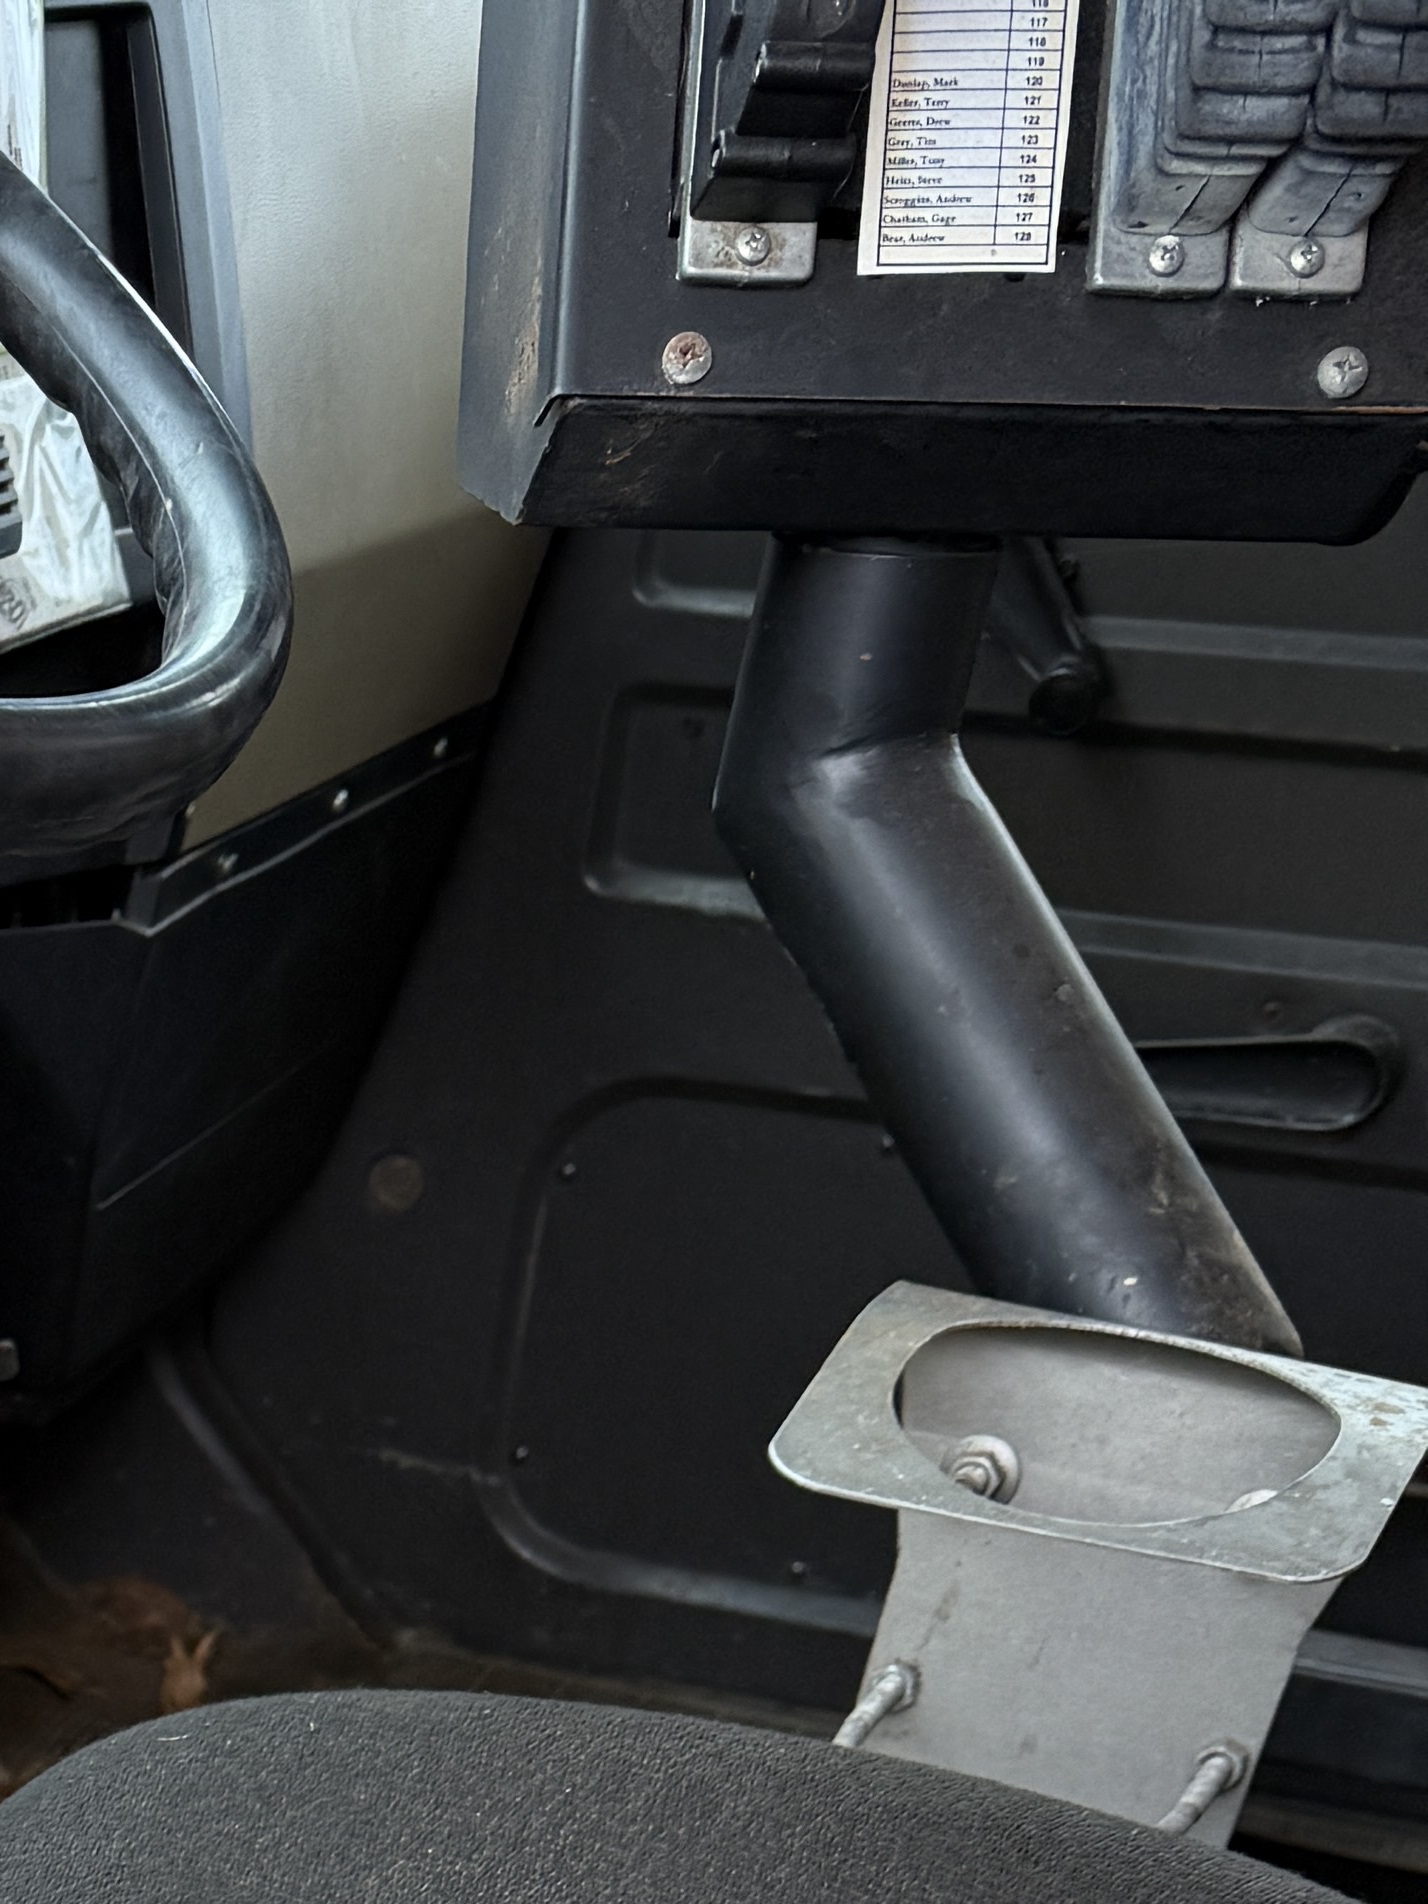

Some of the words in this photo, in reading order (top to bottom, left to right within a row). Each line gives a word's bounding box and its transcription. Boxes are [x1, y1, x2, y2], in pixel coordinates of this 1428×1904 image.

[1023, 115, 1040, 125] 122
[1020, 154, 1037, 164] 124
[1016, 212, 1033, 222] 127
